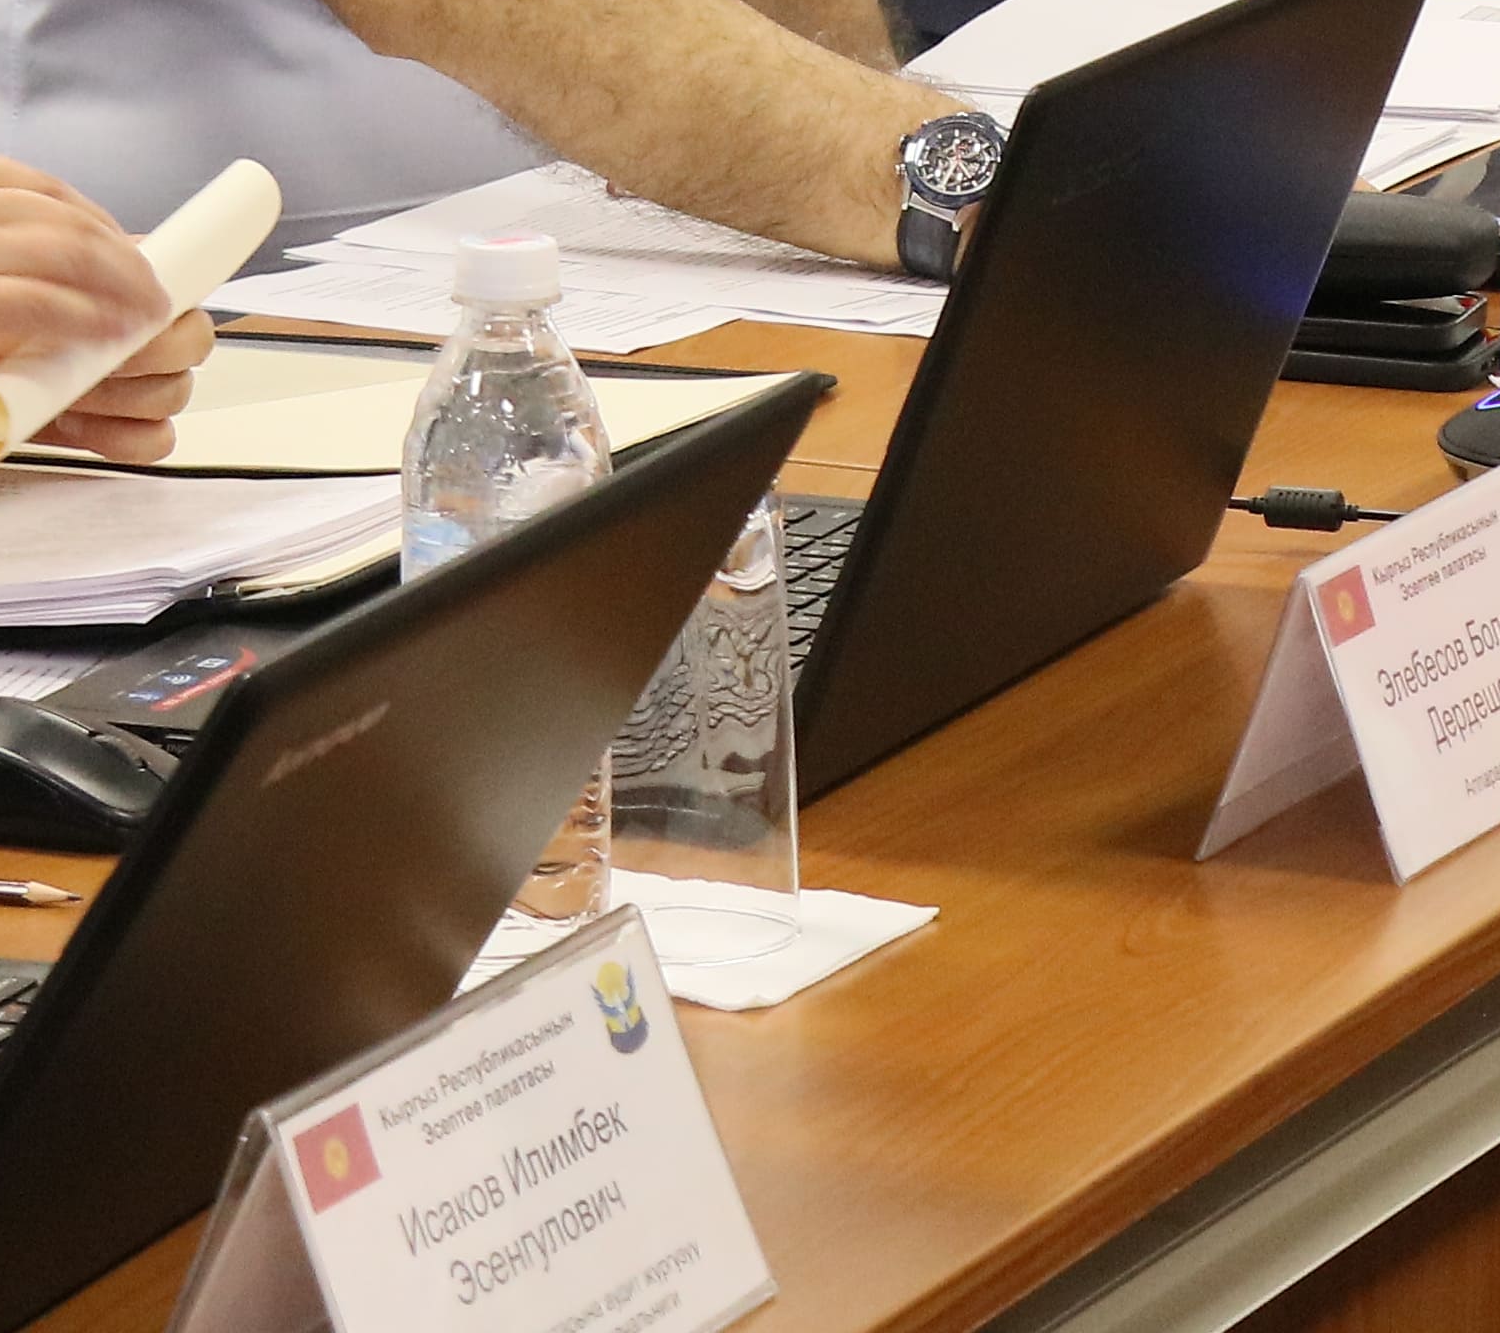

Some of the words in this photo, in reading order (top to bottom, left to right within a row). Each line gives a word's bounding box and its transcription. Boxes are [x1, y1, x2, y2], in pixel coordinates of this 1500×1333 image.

[1376, 635, 1470, 708] Элебесов
[377, 1085, 439, 1131] Кыргыз
[483, 1060, 558, 1111] палатасы
[398, 1171, 508, 1258] Исаков
[501, 1100, 631, 1197] Илимбек
[448, 1179, 628, 1306] Эсенгулович
